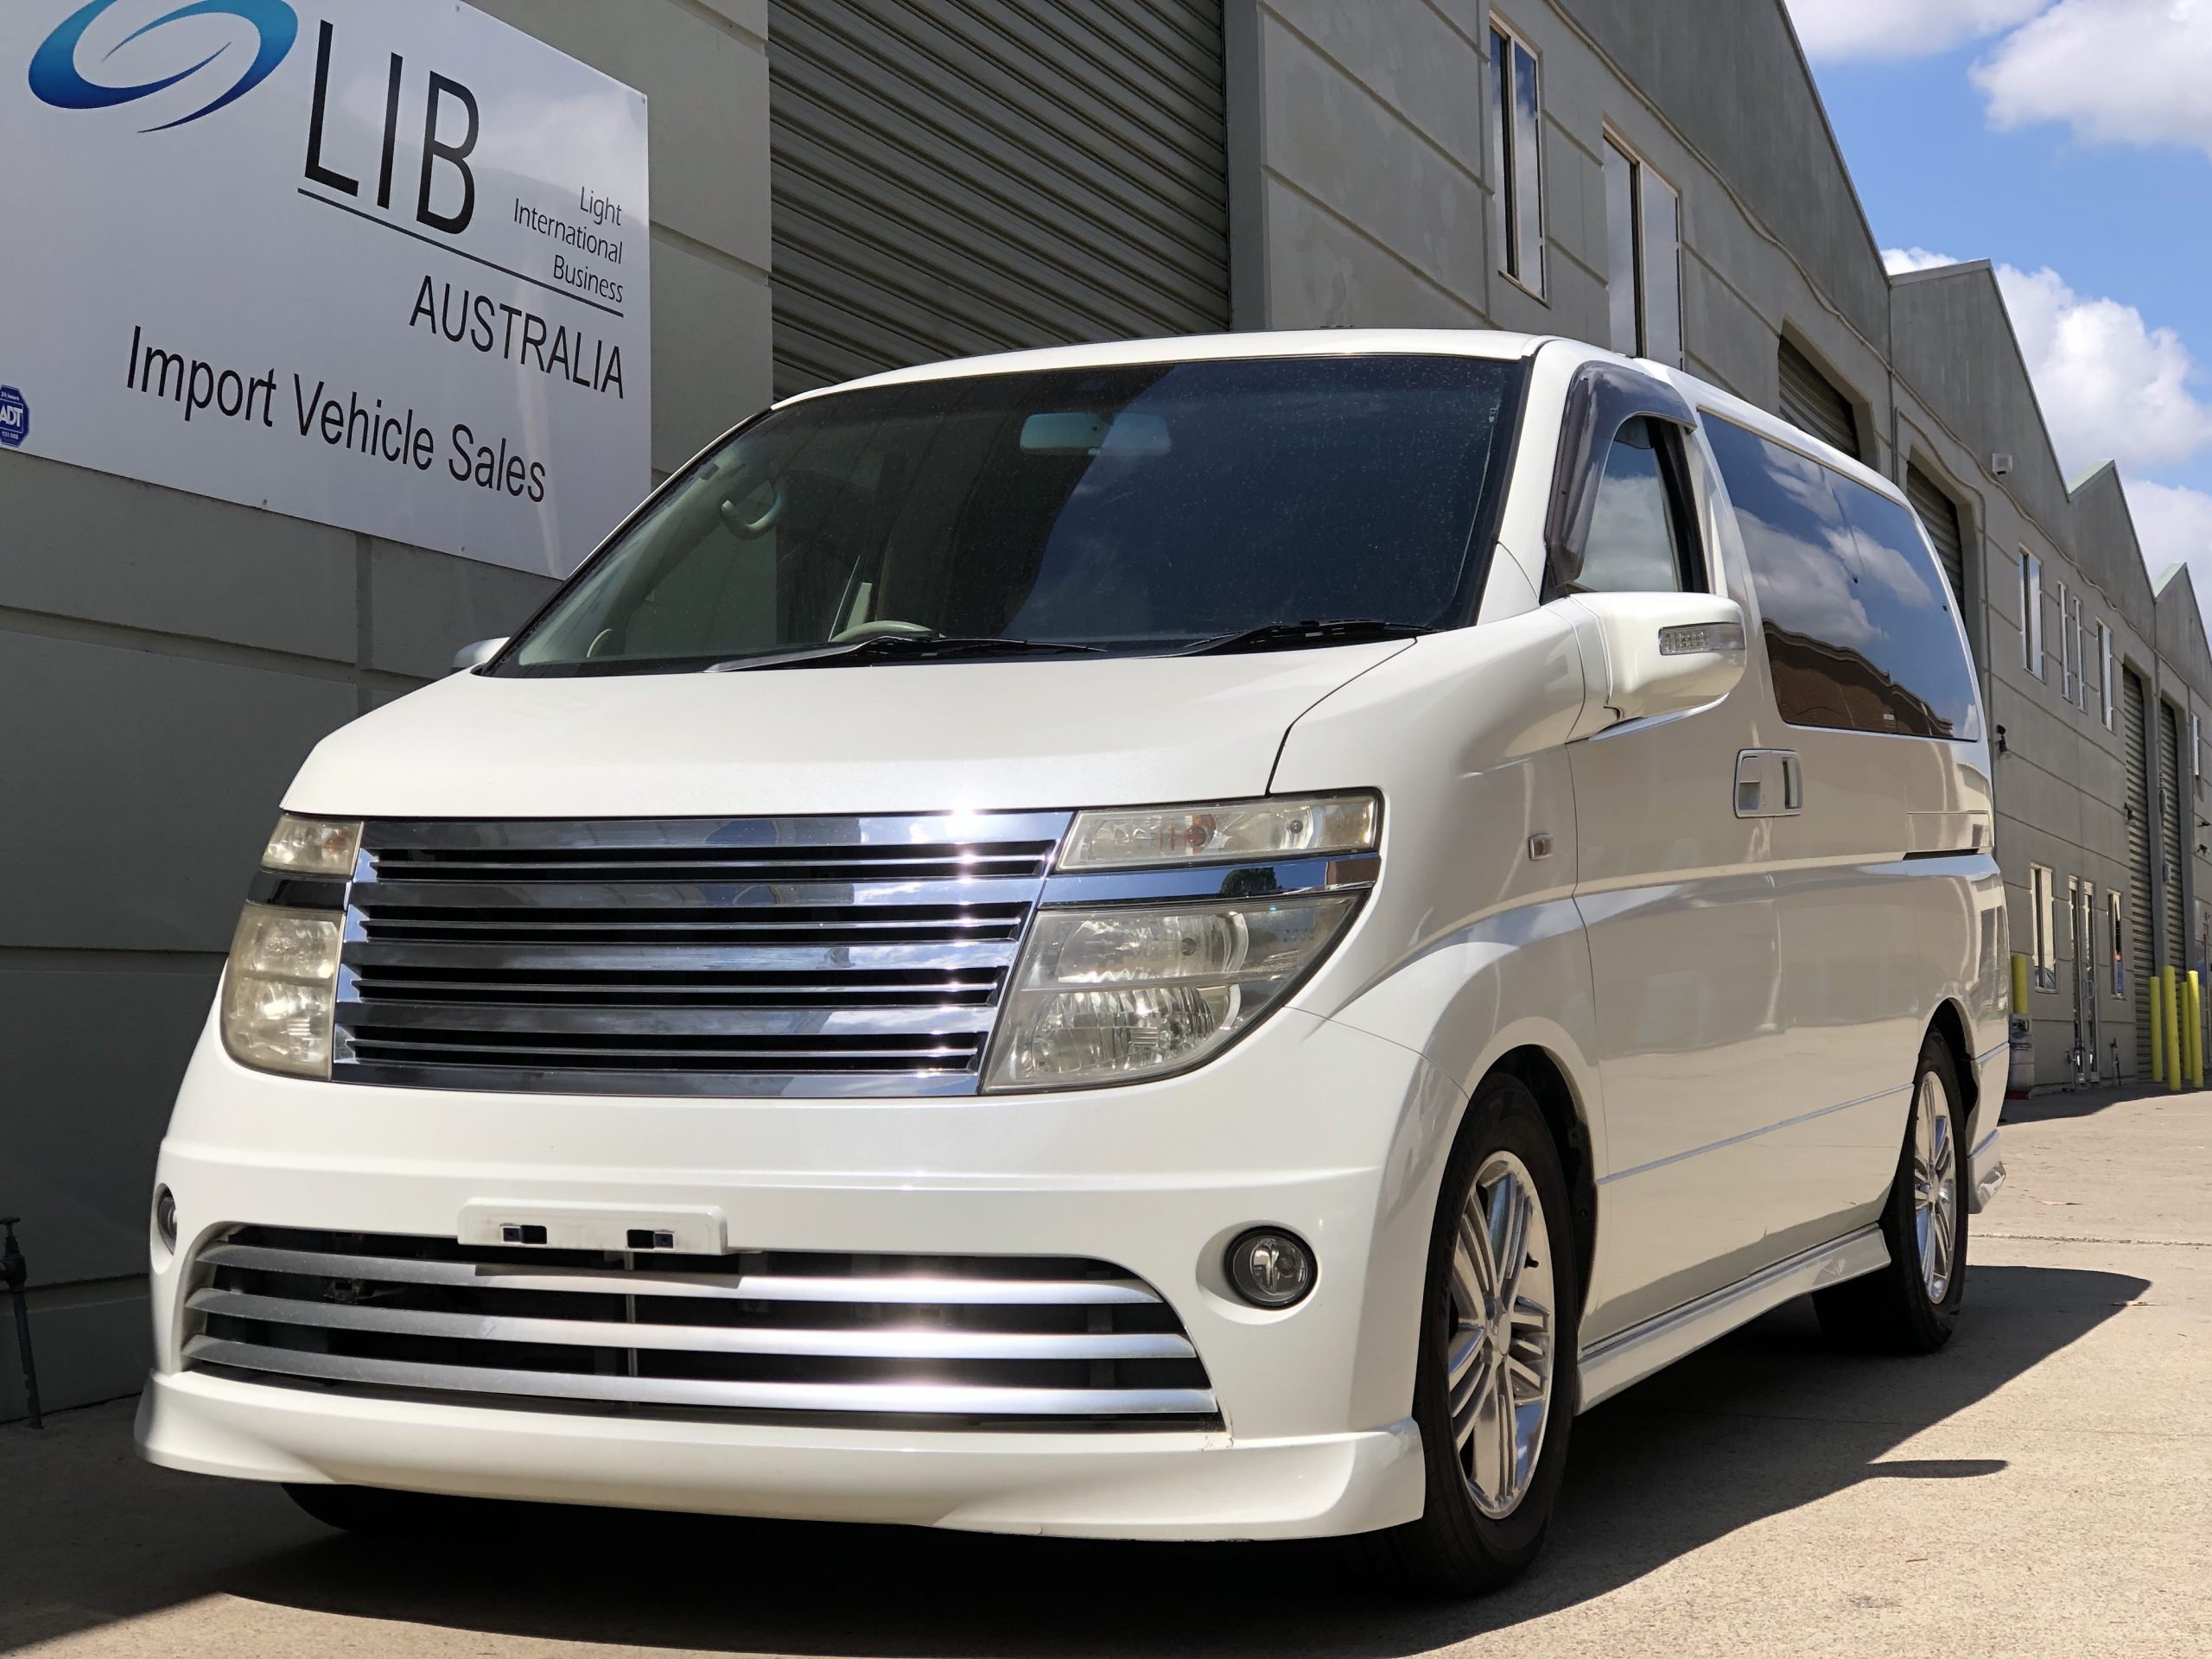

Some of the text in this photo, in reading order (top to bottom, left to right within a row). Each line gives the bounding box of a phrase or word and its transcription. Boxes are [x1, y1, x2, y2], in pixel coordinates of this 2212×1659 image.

[303, 19, 480, 236] LIB
[513, 197, 623, 264] International
[580, 186, 622, 226] Light
[553, 254, 624, 303] Business
[409, 275, 624, 401] AUSTRALIA
[0, 404, 23, 428] ADT
[126, 325, 546, 503] Import Vehicle Sales
